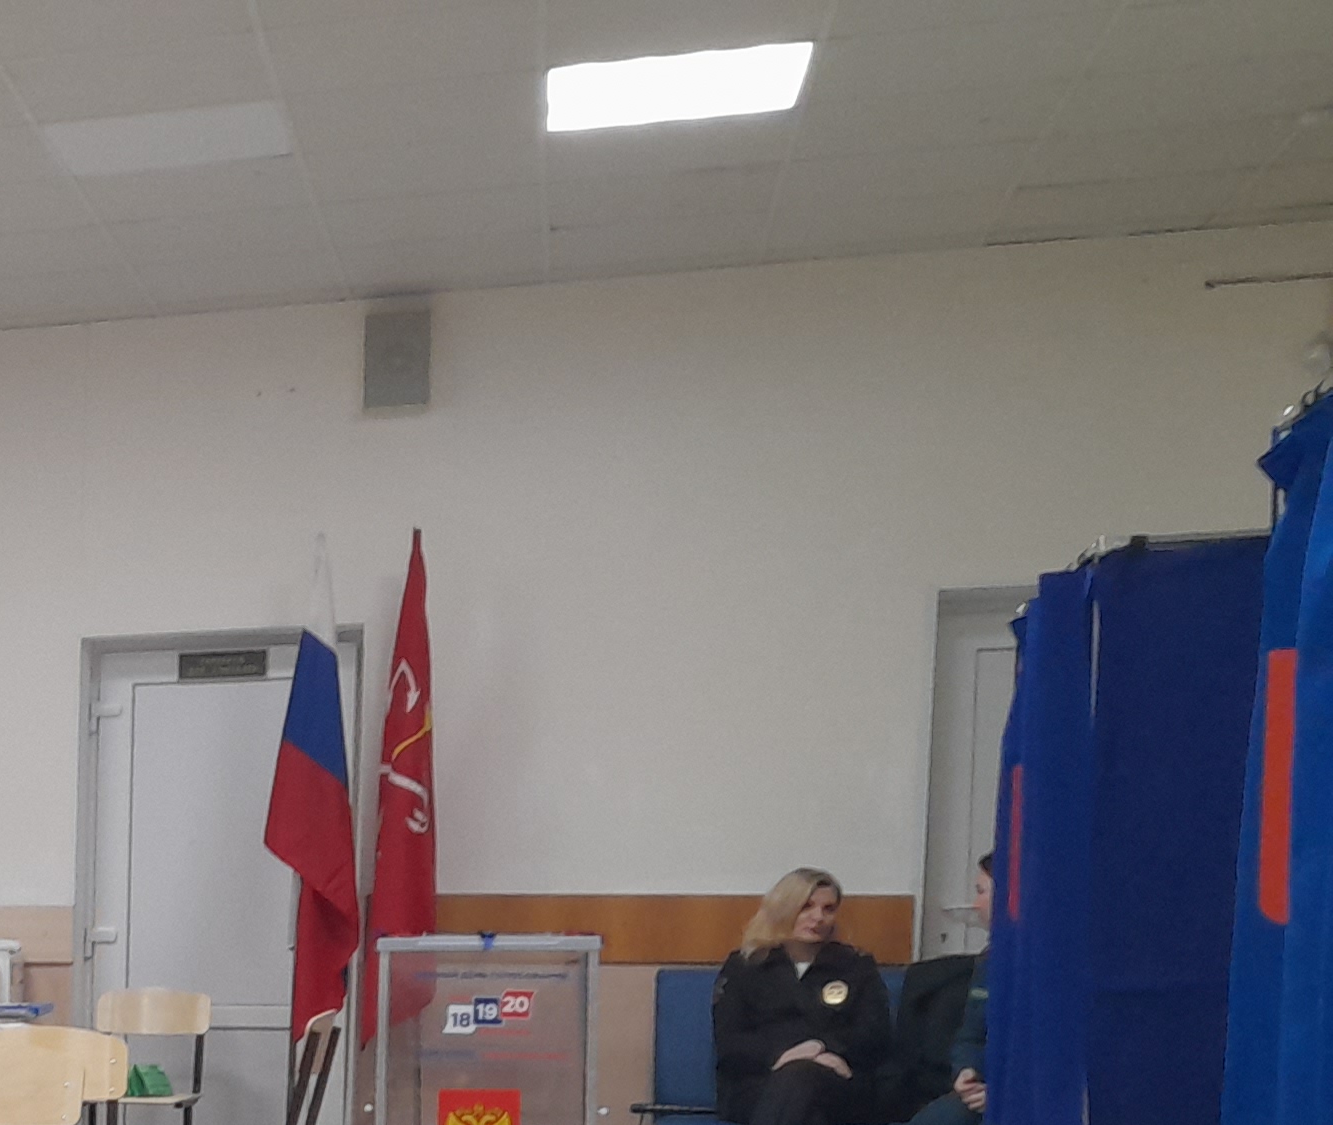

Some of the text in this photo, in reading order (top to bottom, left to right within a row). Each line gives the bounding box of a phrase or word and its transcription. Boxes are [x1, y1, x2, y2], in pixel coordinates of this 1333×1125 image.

[451, 996, 530, 1028] 18 19 20
